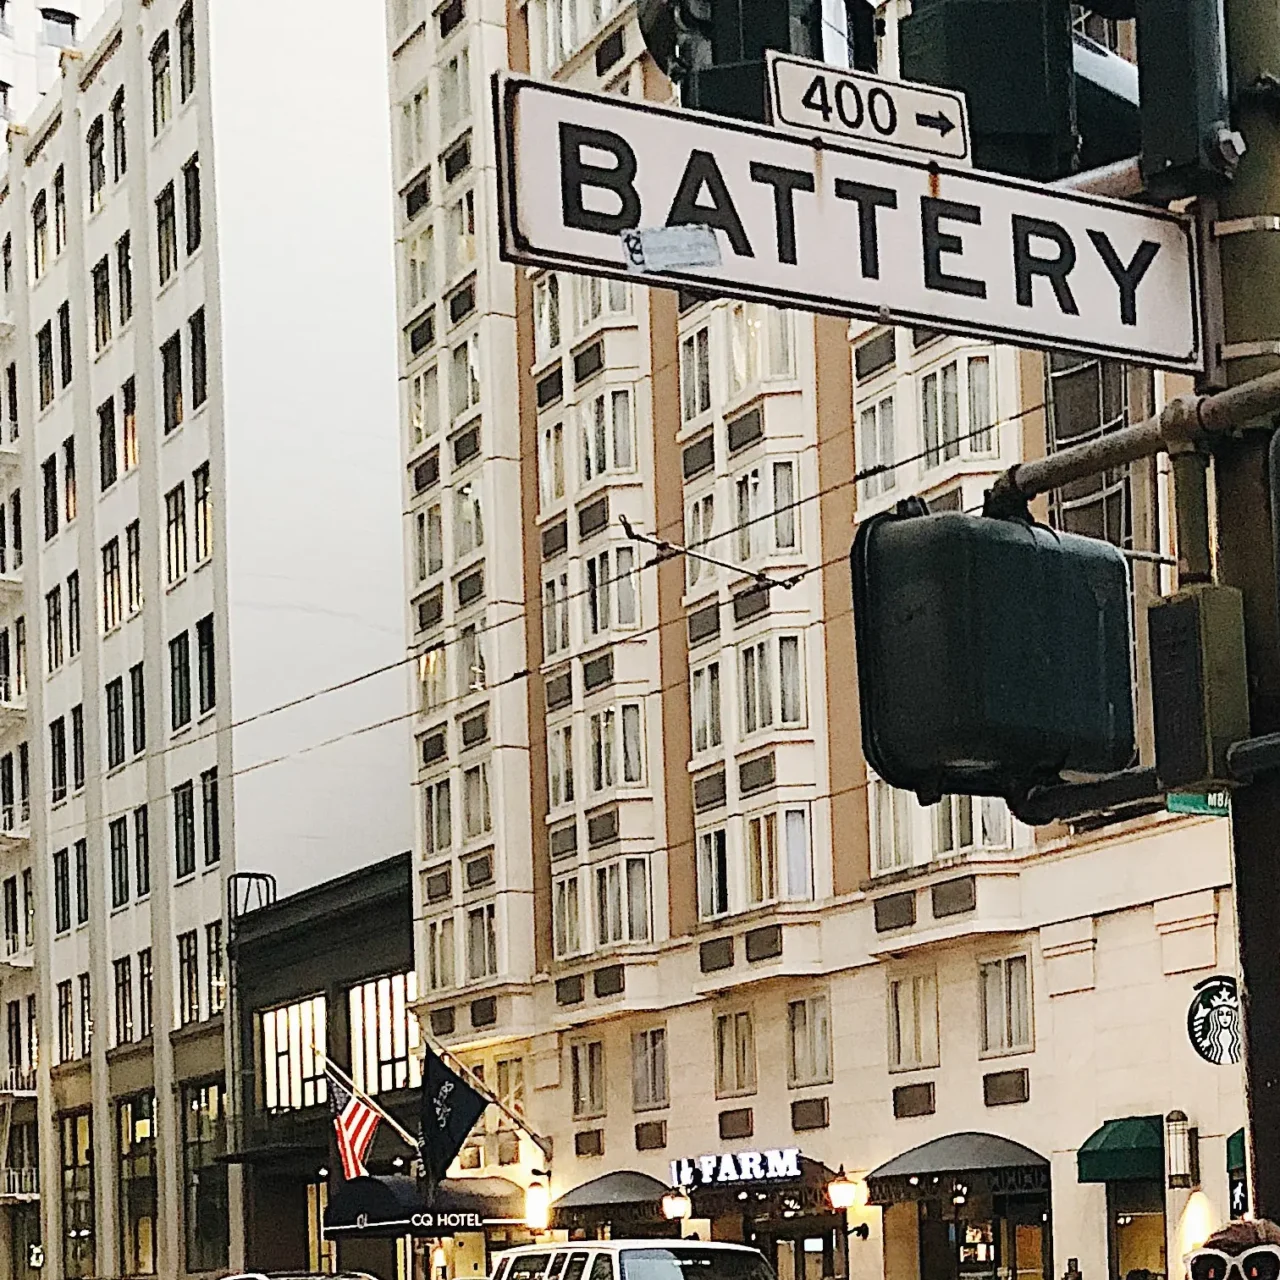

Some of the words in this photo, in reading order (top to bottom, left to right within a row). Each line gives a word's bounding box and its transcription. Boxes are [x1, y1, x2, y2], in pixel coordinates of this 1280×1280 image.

[800, 74, 898, 137] 400
[557, 121, 1162, 327] BATTERY
[410, 1213, 434, 1227] CQ
[437, 1213, 483, 1227] HOTEL
